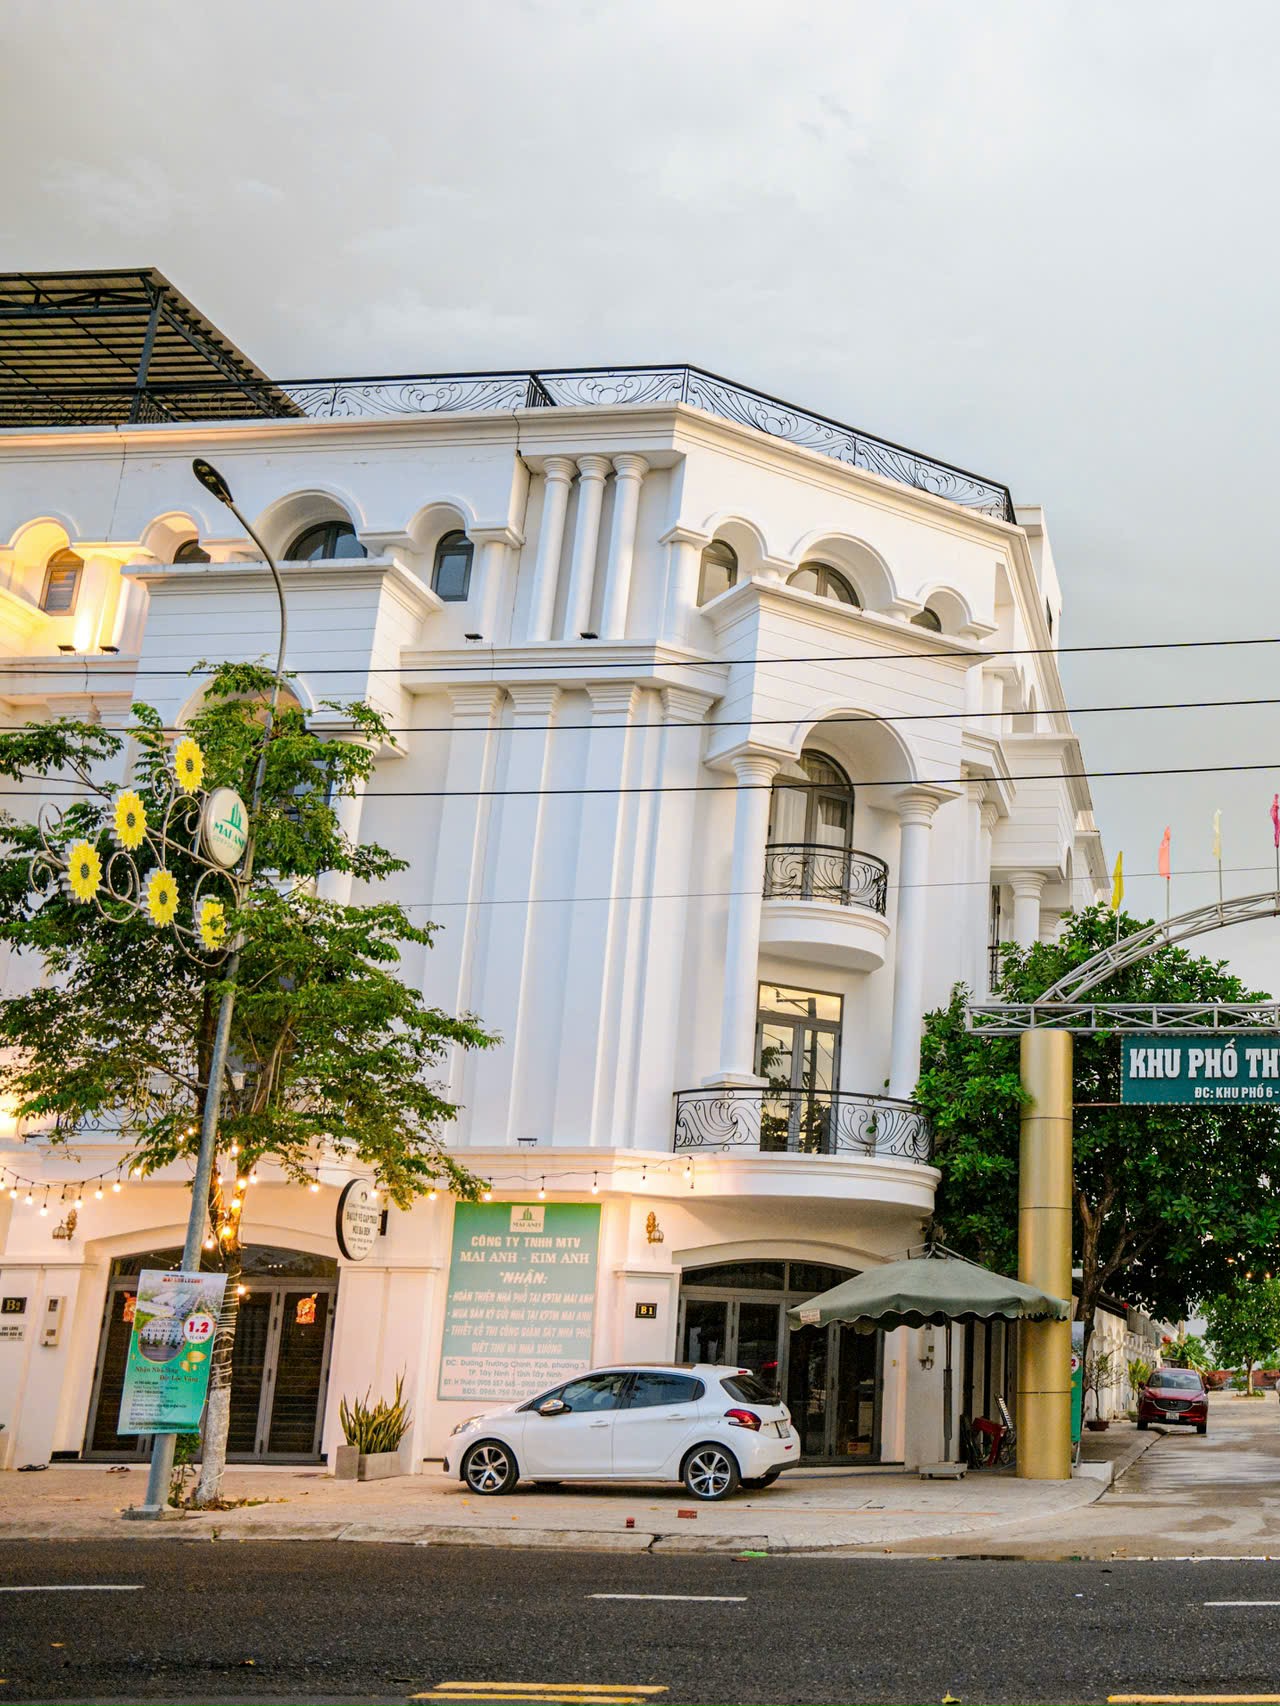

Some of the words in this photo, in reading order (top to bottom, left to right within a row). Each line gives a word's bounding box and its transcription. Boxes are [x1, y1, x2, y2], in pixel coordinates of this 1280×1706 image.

[1129, 1048, 1181, 1078] KHU
[1188, 1037, 1238, 1078] PHỐ
[1194, 1086, 1214, 1098] ĐC:
[1215, 1086, 1239, 1098] KHU
[1241, 1083, 1264, 1098] PHỐ
[1265, 1086, 1272, 1098] 6
[471, 1235, 501, 1247] CÔNG
[506, 1237, 520, 1247] TY
[524, 1237, 552, 1248] TNHH
[555, 1237, 581, 1248] MTV
[460, 1251, 485, 1262] MAI
[489, 1252, 517, 1262] ANH
[530, 1252, 556, 1263] KIM
[560, 1253, 590, 1264] ANH
[640, 1306, 653, 1314] B1
[189, 1320, 209, 1333] 1.2
